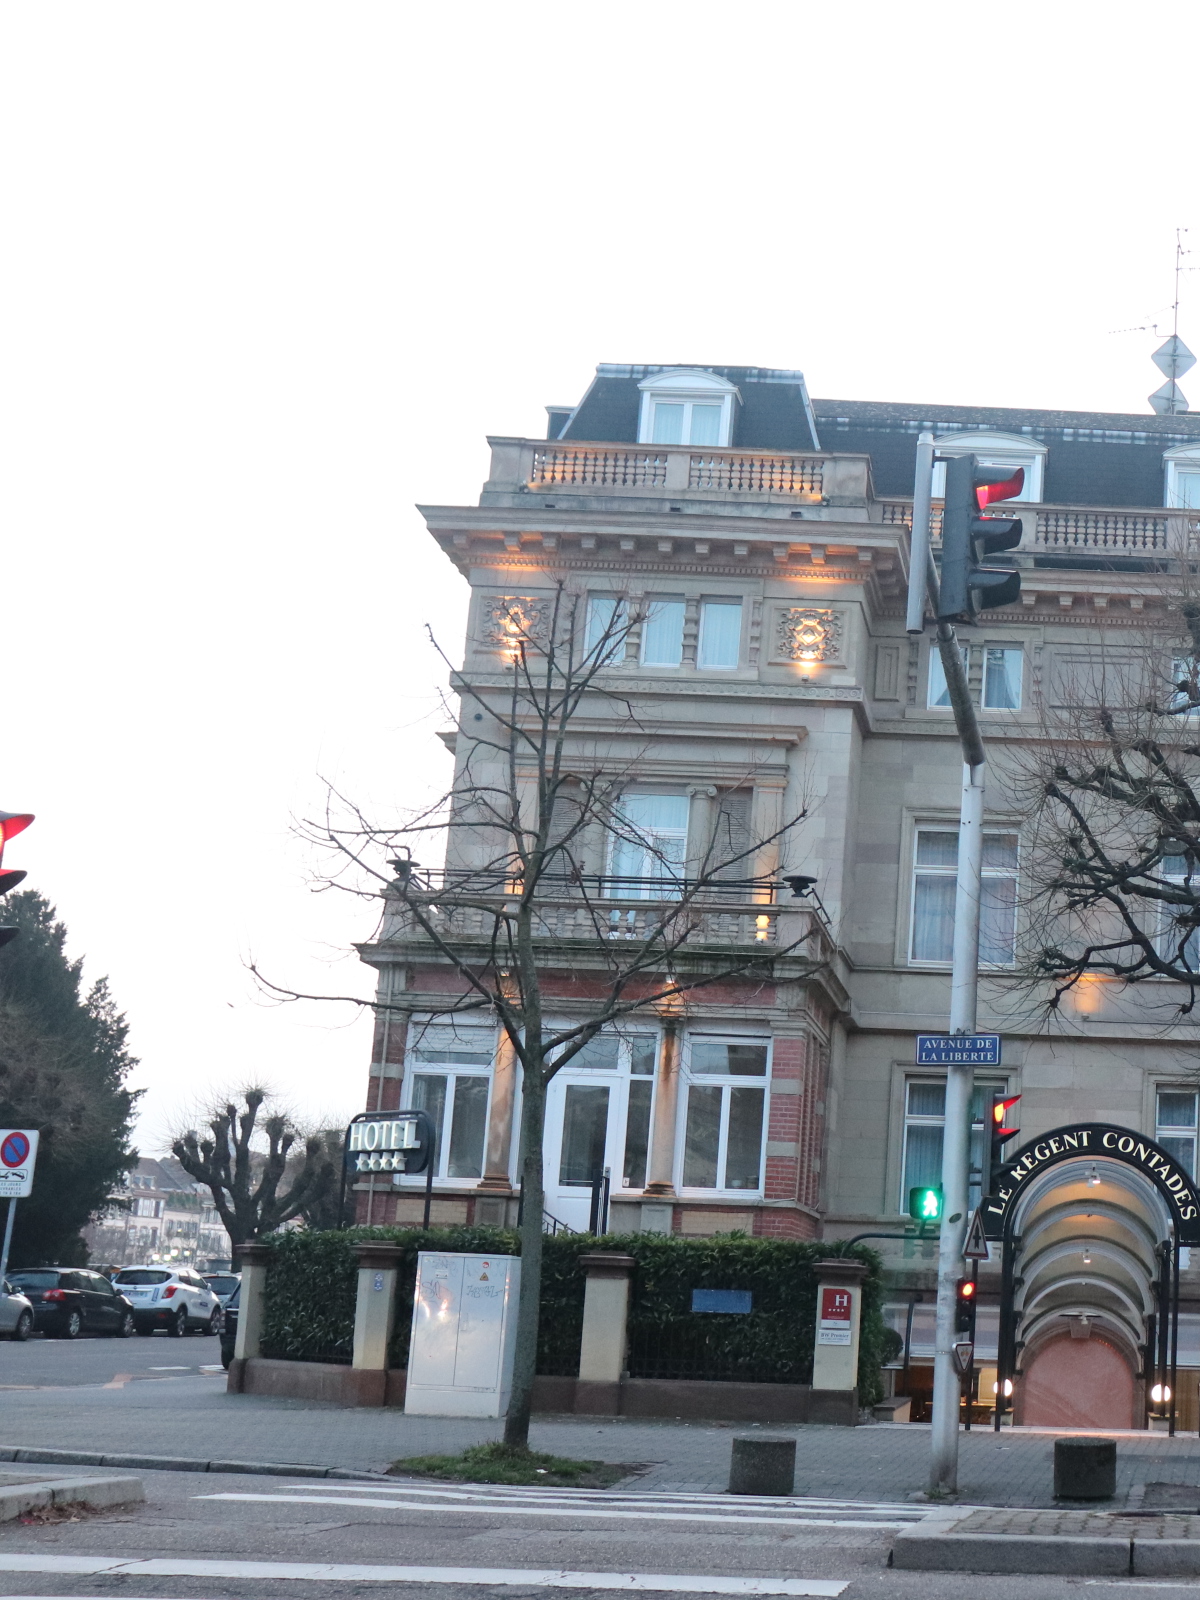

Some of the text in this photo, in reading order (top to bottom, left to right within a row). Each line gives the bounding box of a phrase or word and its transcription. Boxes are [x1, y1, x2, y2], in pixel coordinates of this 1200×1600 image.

[924, 1039, 993, 1049] AVENUE DE
[922, 1051, 994, 1061] LA LIBERTE
[349, 1120, 419, 1151] HOTEL
[988, 1130, 1198, 1221] LE REGENT CONTADES
[835, 1294, 848, 1307] H
